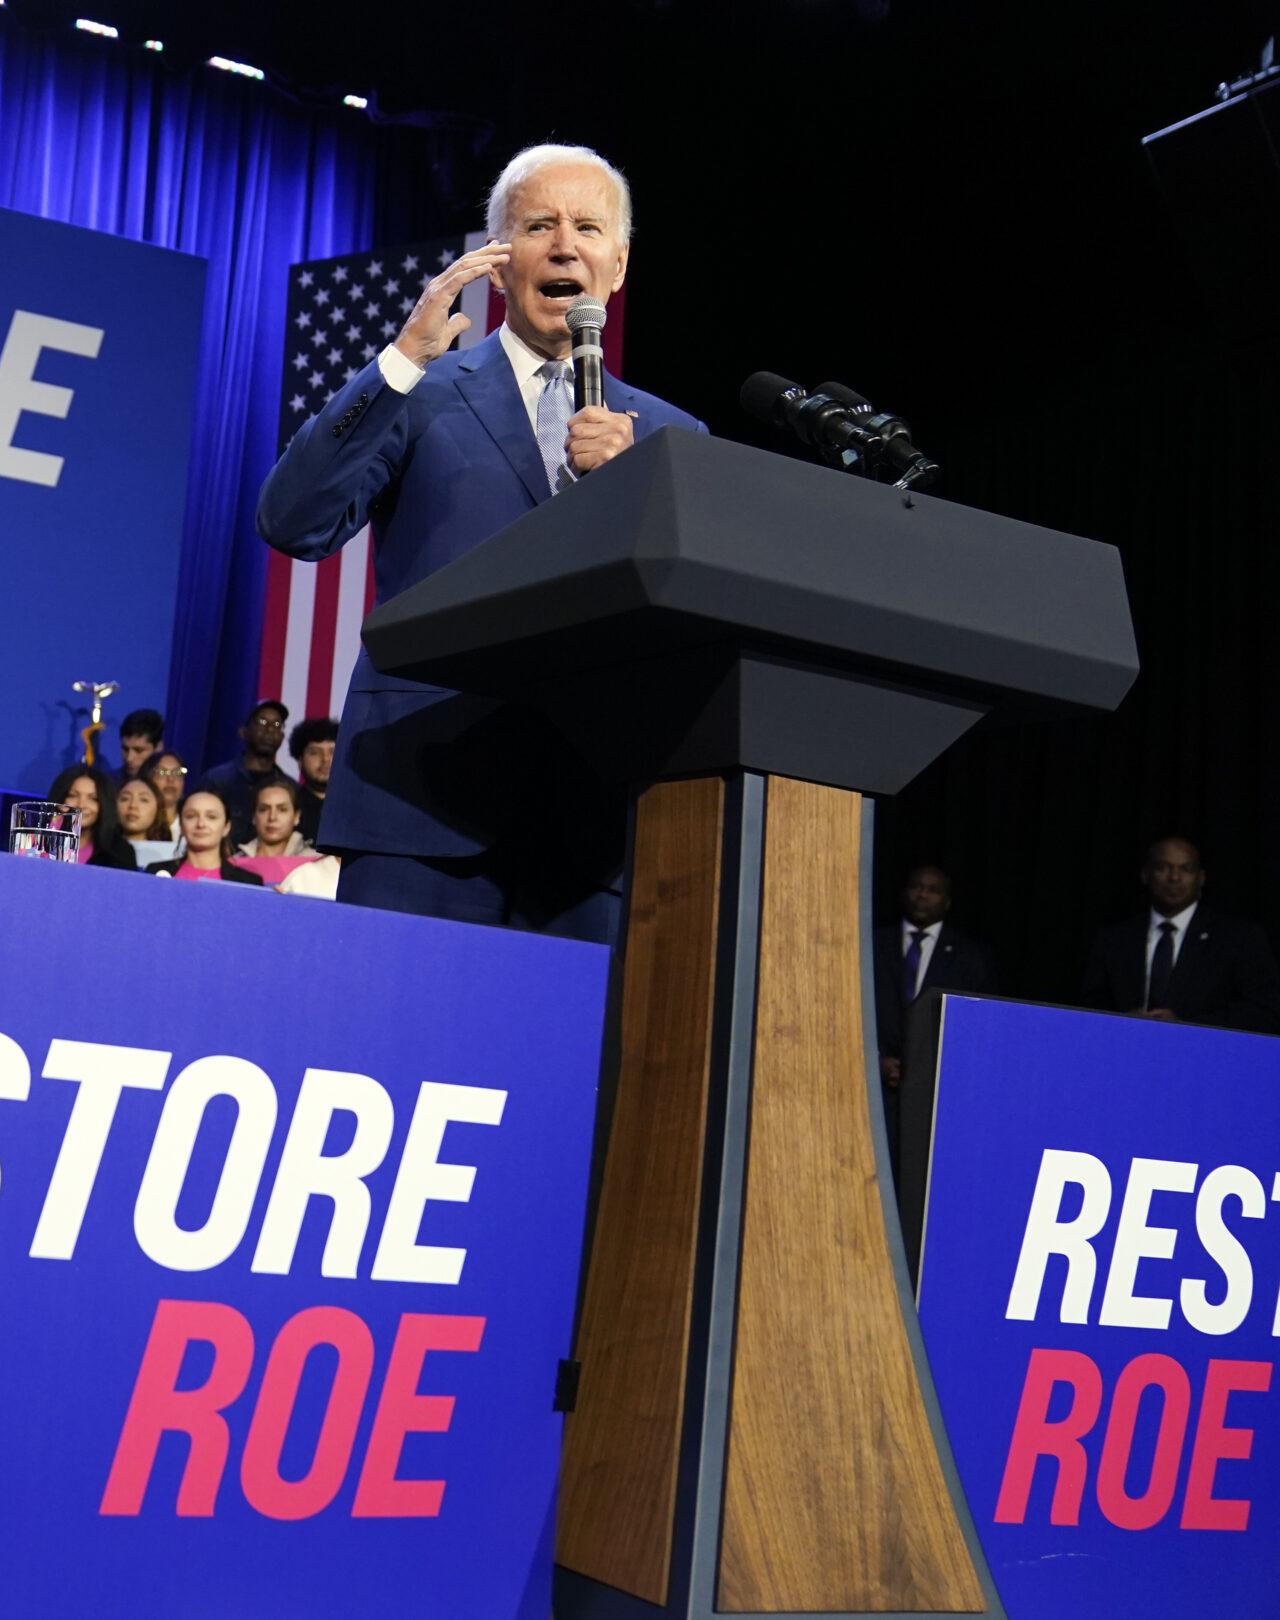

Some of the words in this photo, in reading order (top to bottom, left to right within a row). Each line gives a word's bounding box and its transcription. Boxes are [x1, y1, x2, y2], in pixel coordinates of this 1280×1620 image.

[1004, 1148, 1280, 1337] RES
[99, 1299, 487, 1521] ROE
[993, 1348, 1274, 1531] ROE
